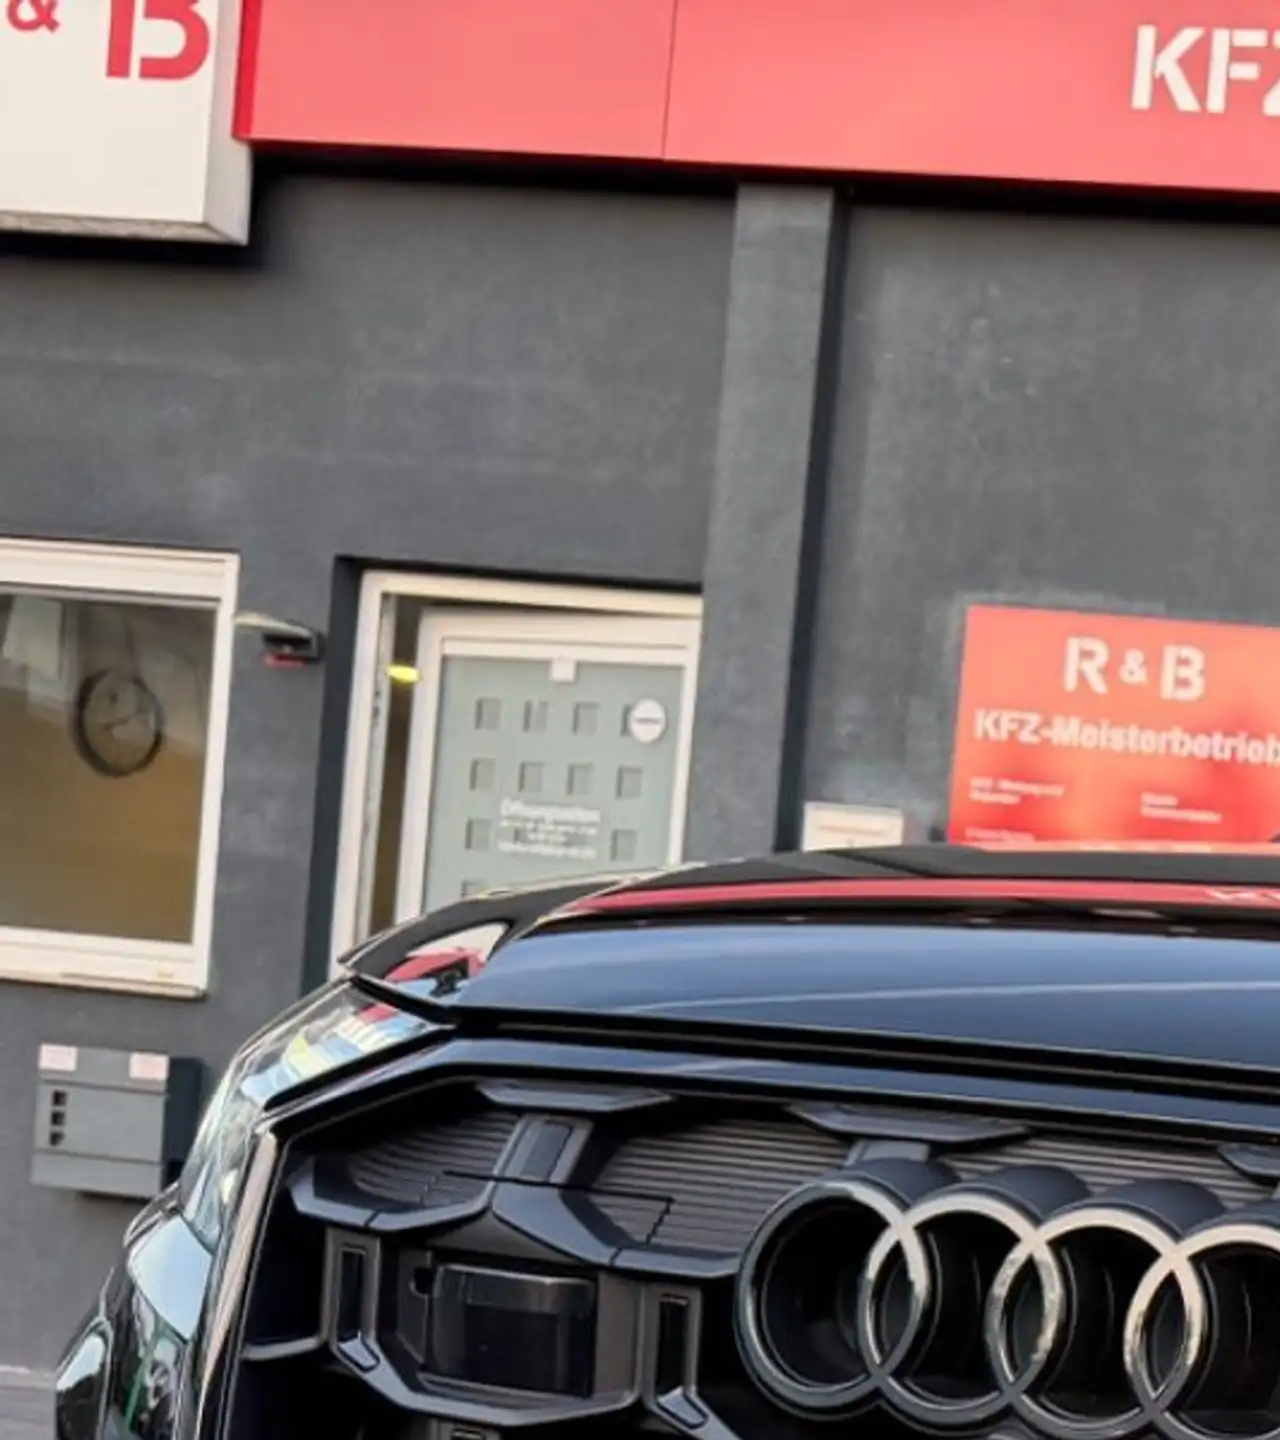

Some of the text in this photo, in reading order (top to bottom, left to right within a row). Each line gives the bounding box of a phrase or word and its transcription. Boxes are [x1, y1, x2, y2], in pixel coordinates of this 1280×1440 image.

[105, 0, 210, 80] B
[1063, 637, 1205, 701] R & B
